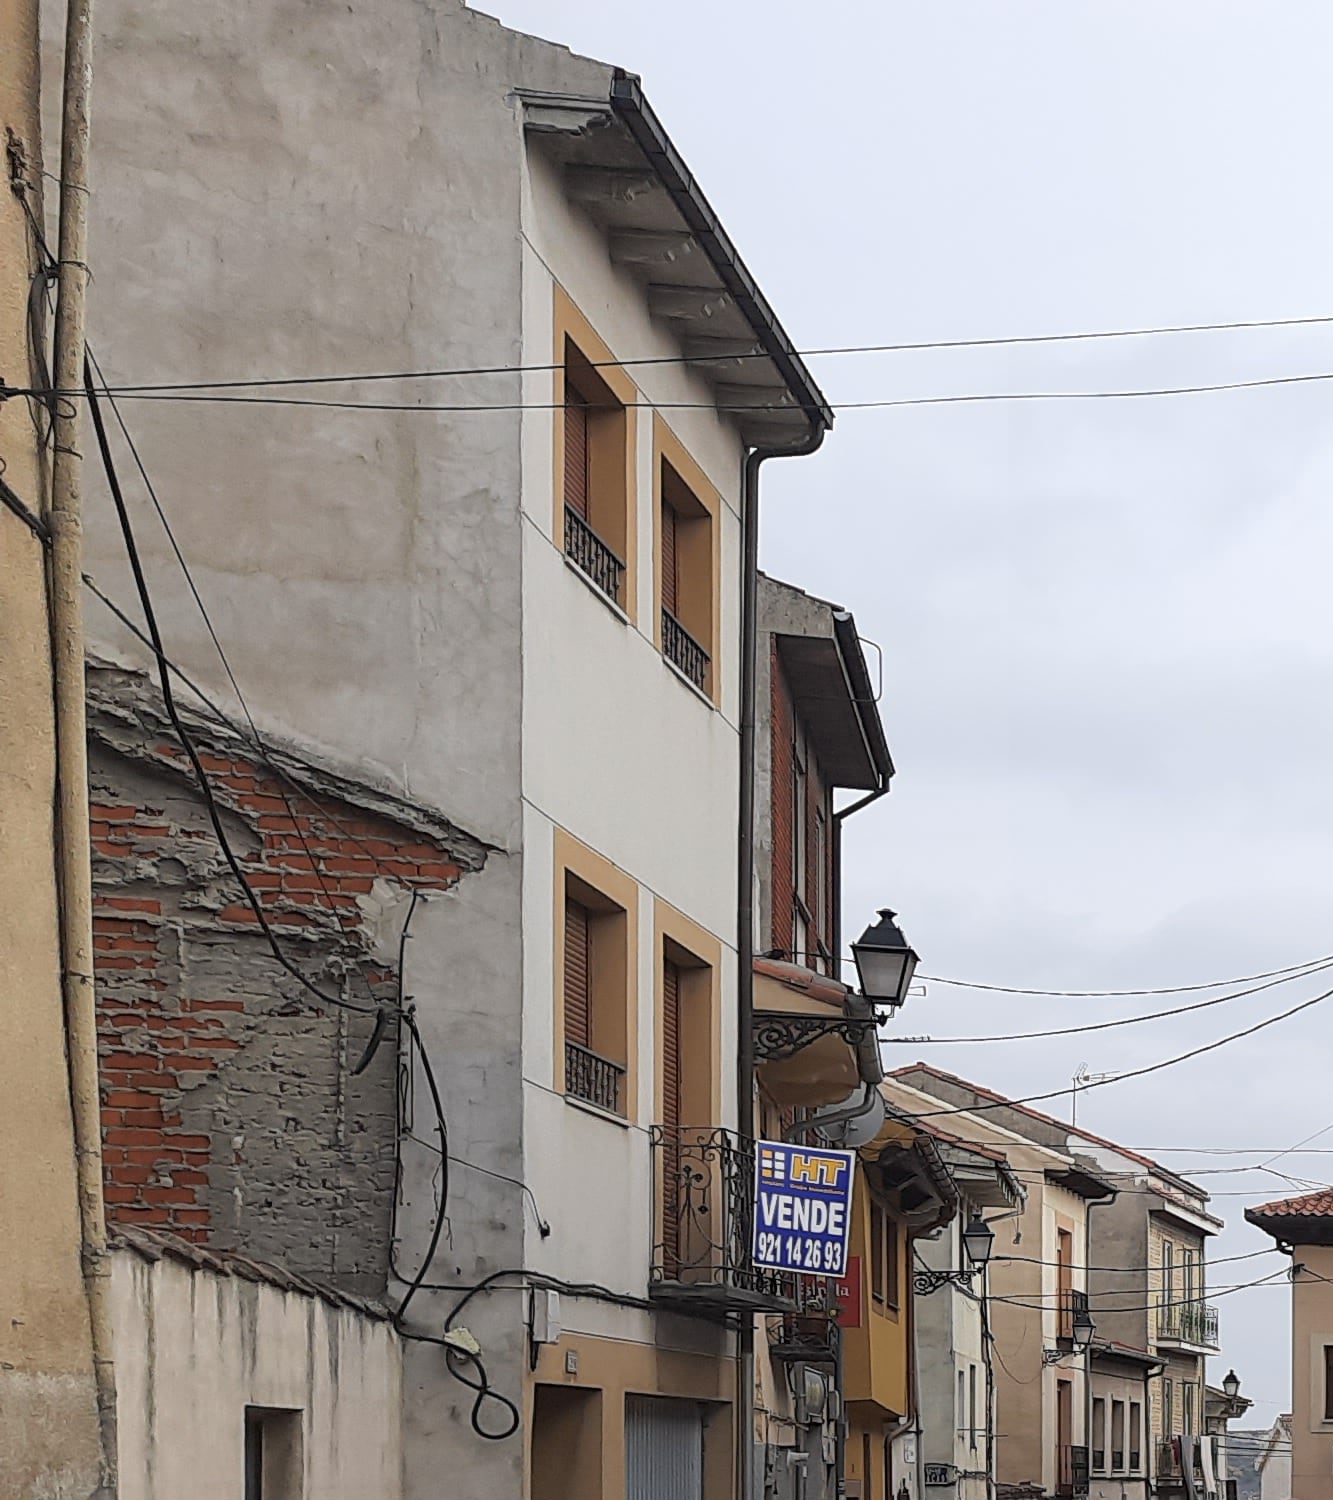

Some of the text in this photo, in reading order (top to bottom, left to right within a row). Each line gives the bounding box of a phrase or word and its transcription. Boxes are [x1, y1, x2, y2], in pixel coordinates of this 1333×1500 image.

[790, 1153, 846, 1186] HT
[760, 1191, 844, 1236] VENDE
[758, 1232, 842, 1271] 921 14 26 93
